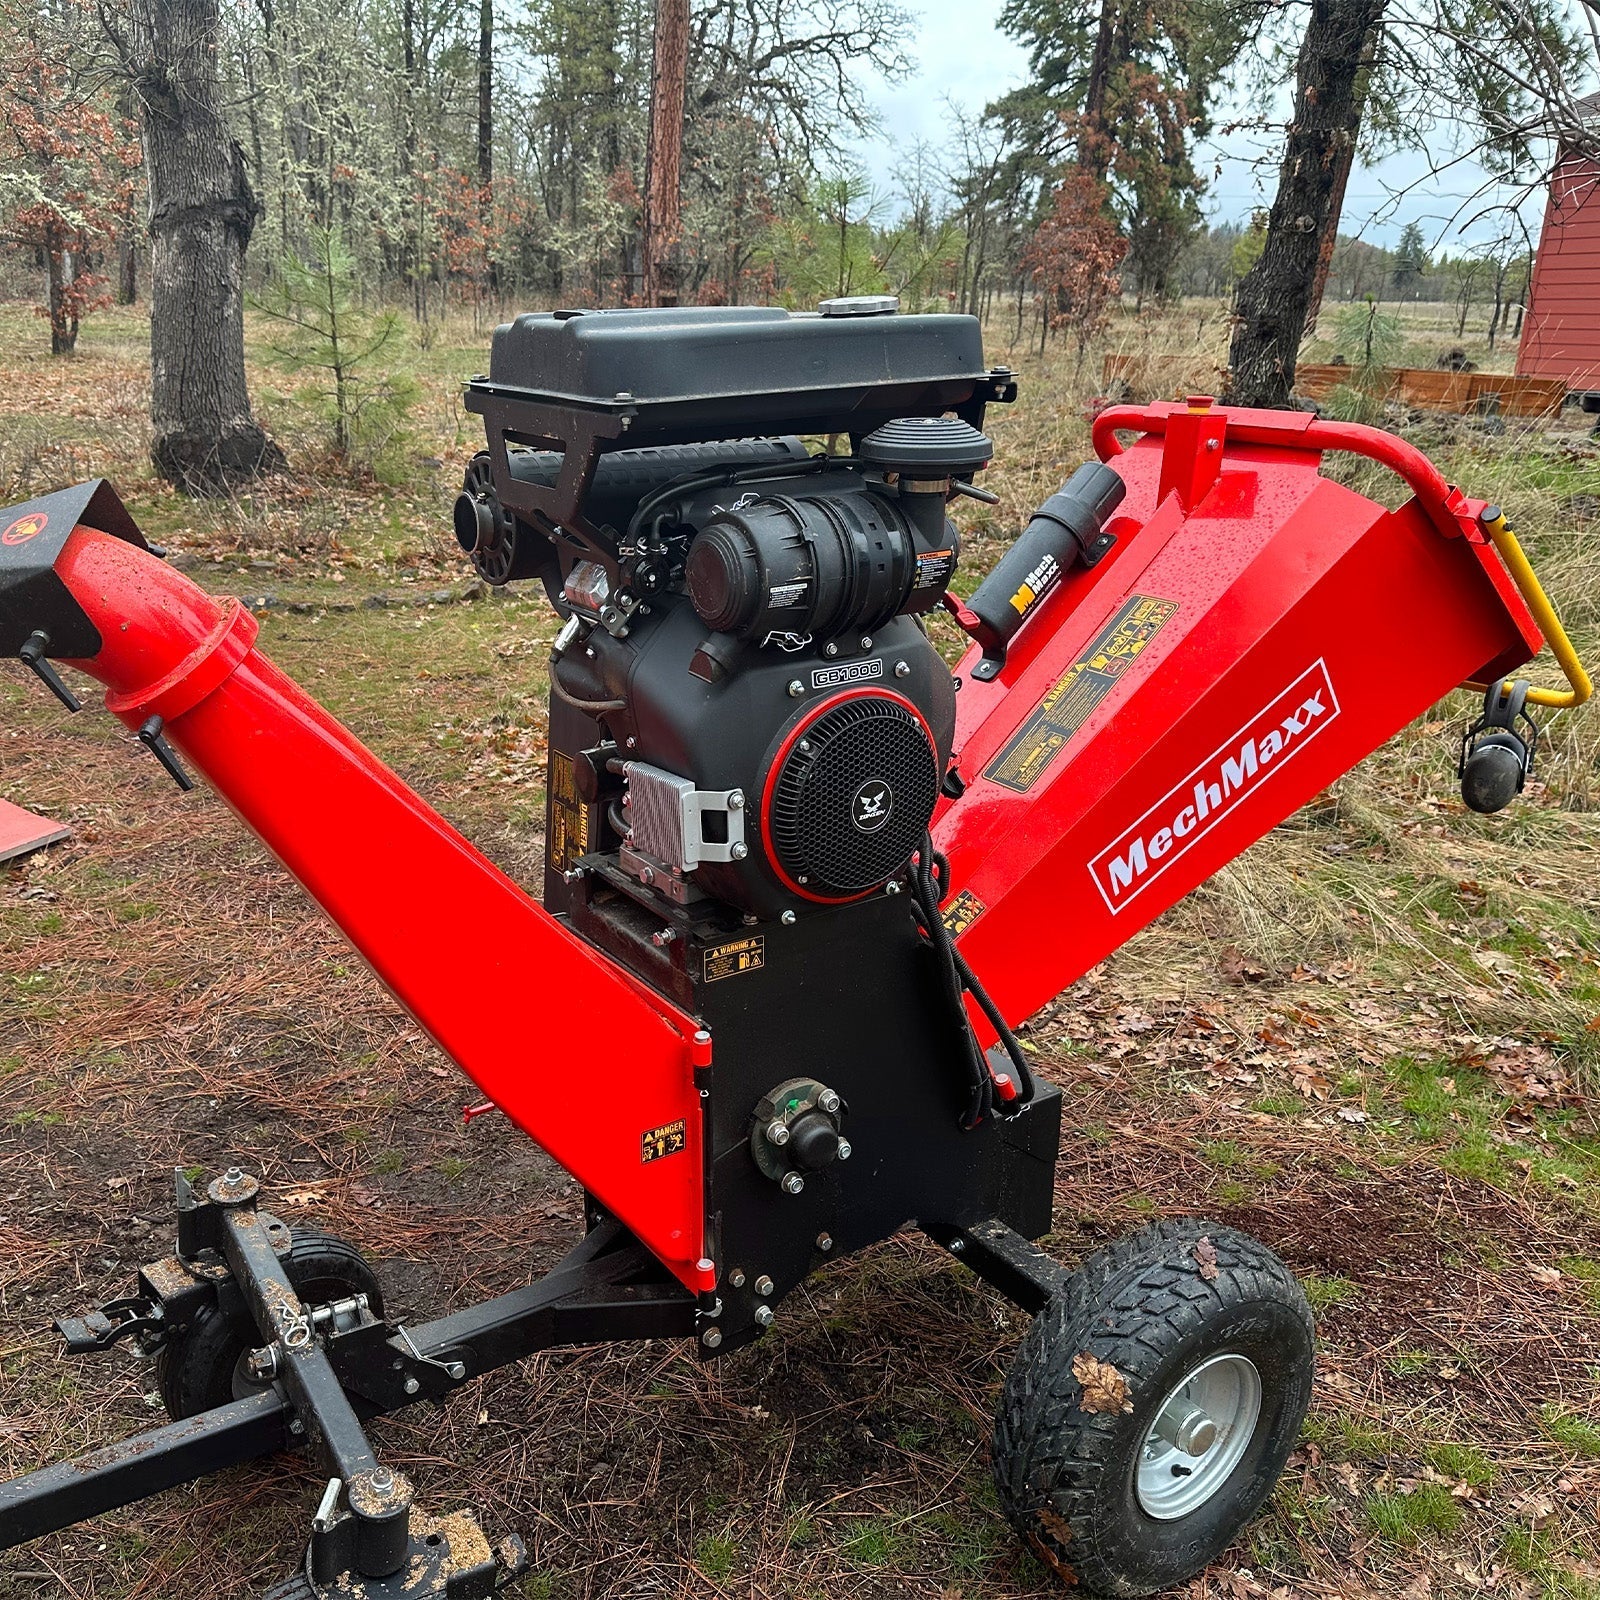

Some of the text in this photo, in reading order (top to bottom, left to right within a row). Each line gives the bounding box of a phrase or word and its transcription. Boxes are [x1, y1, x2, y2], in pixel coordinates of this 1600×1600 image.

[1024, 553, 1055, 588] Mech
[1031, 561, 1060, 595] Maxx
[816, 662, 880, 685] GB1000
[1047, 671, 1077, 701] DANGER
[1107, 687, 1327, 896] MechMaxx
[580, 803, 588, 847] DANGER
[720, 940, 749, 954] WARNING
[654, 1121, 684, 1139] DANGER
